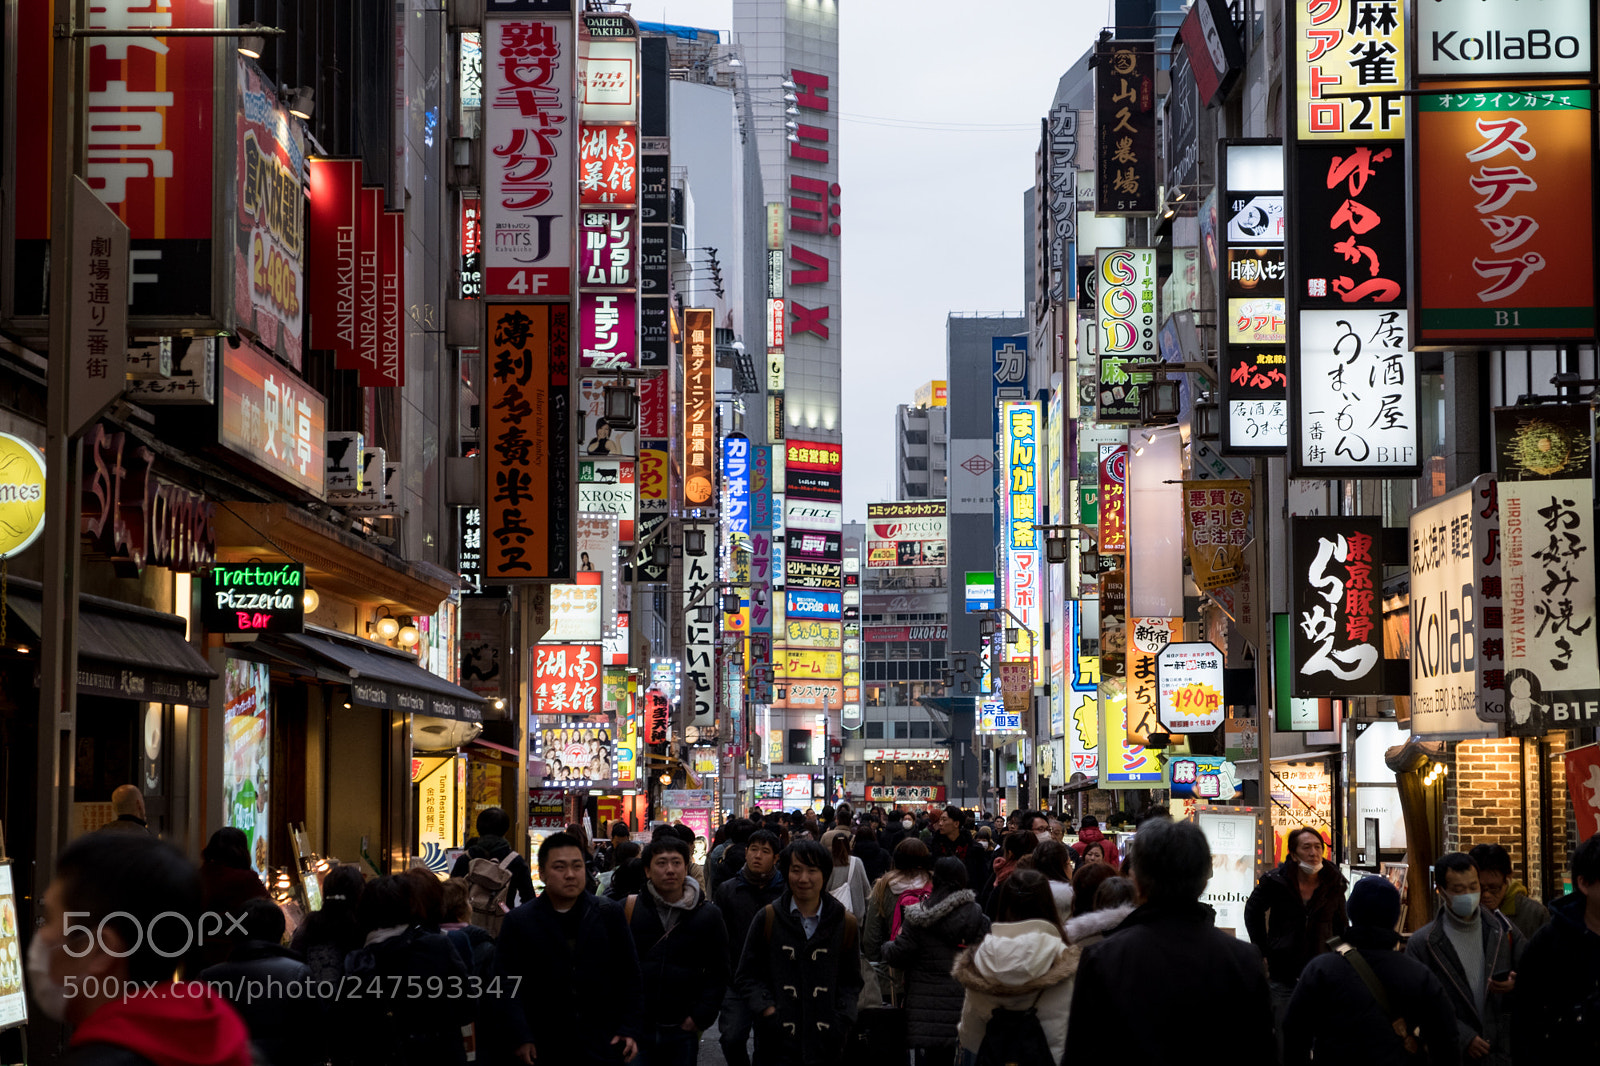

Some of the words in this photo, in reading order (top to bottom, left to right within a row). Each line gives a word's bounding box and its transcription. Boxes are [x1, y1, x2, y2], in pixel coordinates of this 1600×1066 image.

[1347, 0, 1399, 86] 麻雀
[1432, 29, 1580, 61] KollaBo
[1306, 0, 1343, 132] クアトロ
[1348, 96, 1402, 131] 2F
[1439, 92, 1572, 109] オンラインカフェ
[493, 21, 567, 211] 熟女キャバクラ
[1111, 78, 1140, 195] 山久農場
[598, 192, 617, 203] 4F
[1117, 200, 1138, 210] 5F
[1231, 200, 1246, 212] 4F
[1465, 116, 1546, 302] ステップ
[586, 231, 608, 284] ルーム
[610, 213, 631, 285] レンタル
[337, 226, 353, 343] ANRAKUTEI
[507, 270, 550, 294] 4F
[1141, 253, 1154, 314] リーチ麻雀
[86, 236, 112, 379] 劇場通り一番街
[360, 251, 376, 363] ANRAKUTEI
[1101, 250, 1139, 352] GOD
[382, 273, 398, 380] ANRAKUTEI
[594, 296, 619, 350] エデン
[1237, 315, 1284, 332] クアト
[1494, 310, 1520, 327] B1
[552, 311, 569, 377] 炭火串焼
[1100, 356, 1153, 385] 麻雀
[1367, 311, 1409, 431] 居酒屋
[691, 329, 706, 468] 個室ダイニング居酒屋
[1327, 319, 1371, 462] うまいもん
[1232, 402, 1284, 417] 居酒屋
[1101, 446, 1113, 454] 3F
[1307, 409, 1327, 464] 一番街
[788, 446, 840, 466] 全店営業中
[1376, 446, 1415, 463] B1F
[727, 438, 748, 518] カラオケ
[1011, 410, 1036, 549] まんが喫茶
[581, 490, 633, 502] XROSS
[587, 502, 627, 514] CASA
[868, 504, 946, 516] コミック&ネットカフェ
[1189, 489, 1245, 507] 悪質な
[772, 498, 782, 531] SEGA
[1110, 483, 1124, 544] カリーナ
[1190, 509, 1246, 528] 客引き
[1192, 528, 1247, 547] に注意
[1506, 497, 1524, 568] HIROSHIMA
[214, 565, 301, 587] Trattoria
[772, 547, 782, 580] SEGA
[1014, 552, 1036, 624] マンボー
[1345, 530, 1375, 643] 東京豚骨
[1531, 495, 1592, 672] お好み焼き
[216, 588, 295, 610] Pizzeria
[237, 611, 273, 630] Bar
[909, 626, 936, 640] LUXOR
[1135, 625, 1170, 643] 新宿
[1147, 643, 1159, 651] の
[536, 646, 598, 682] 湖南
[788, 658, 822, 673] ゲーム
[535, 682, 548, 712] 4F
[790, 684, 838, 697] メンズサウナ
[1175, 688, 1219, 708] 190円
[1435, 688, 1450, 717] BBQ
[994, 715, 1021, 727] 個室
[1552, 701, 1600, 722] B1F
[875, 749, 909, 761] コーヒー
[1198, 764, 1220, 773] フリー
[439, 774, 447, 792] Tuna
[785, 785, 810, 796] ゲーム
[871, 787, 932, 798] 無料案内所
[438, 794, 447, 841] Restaurant
[1207, 891, 1250, 903] noble
